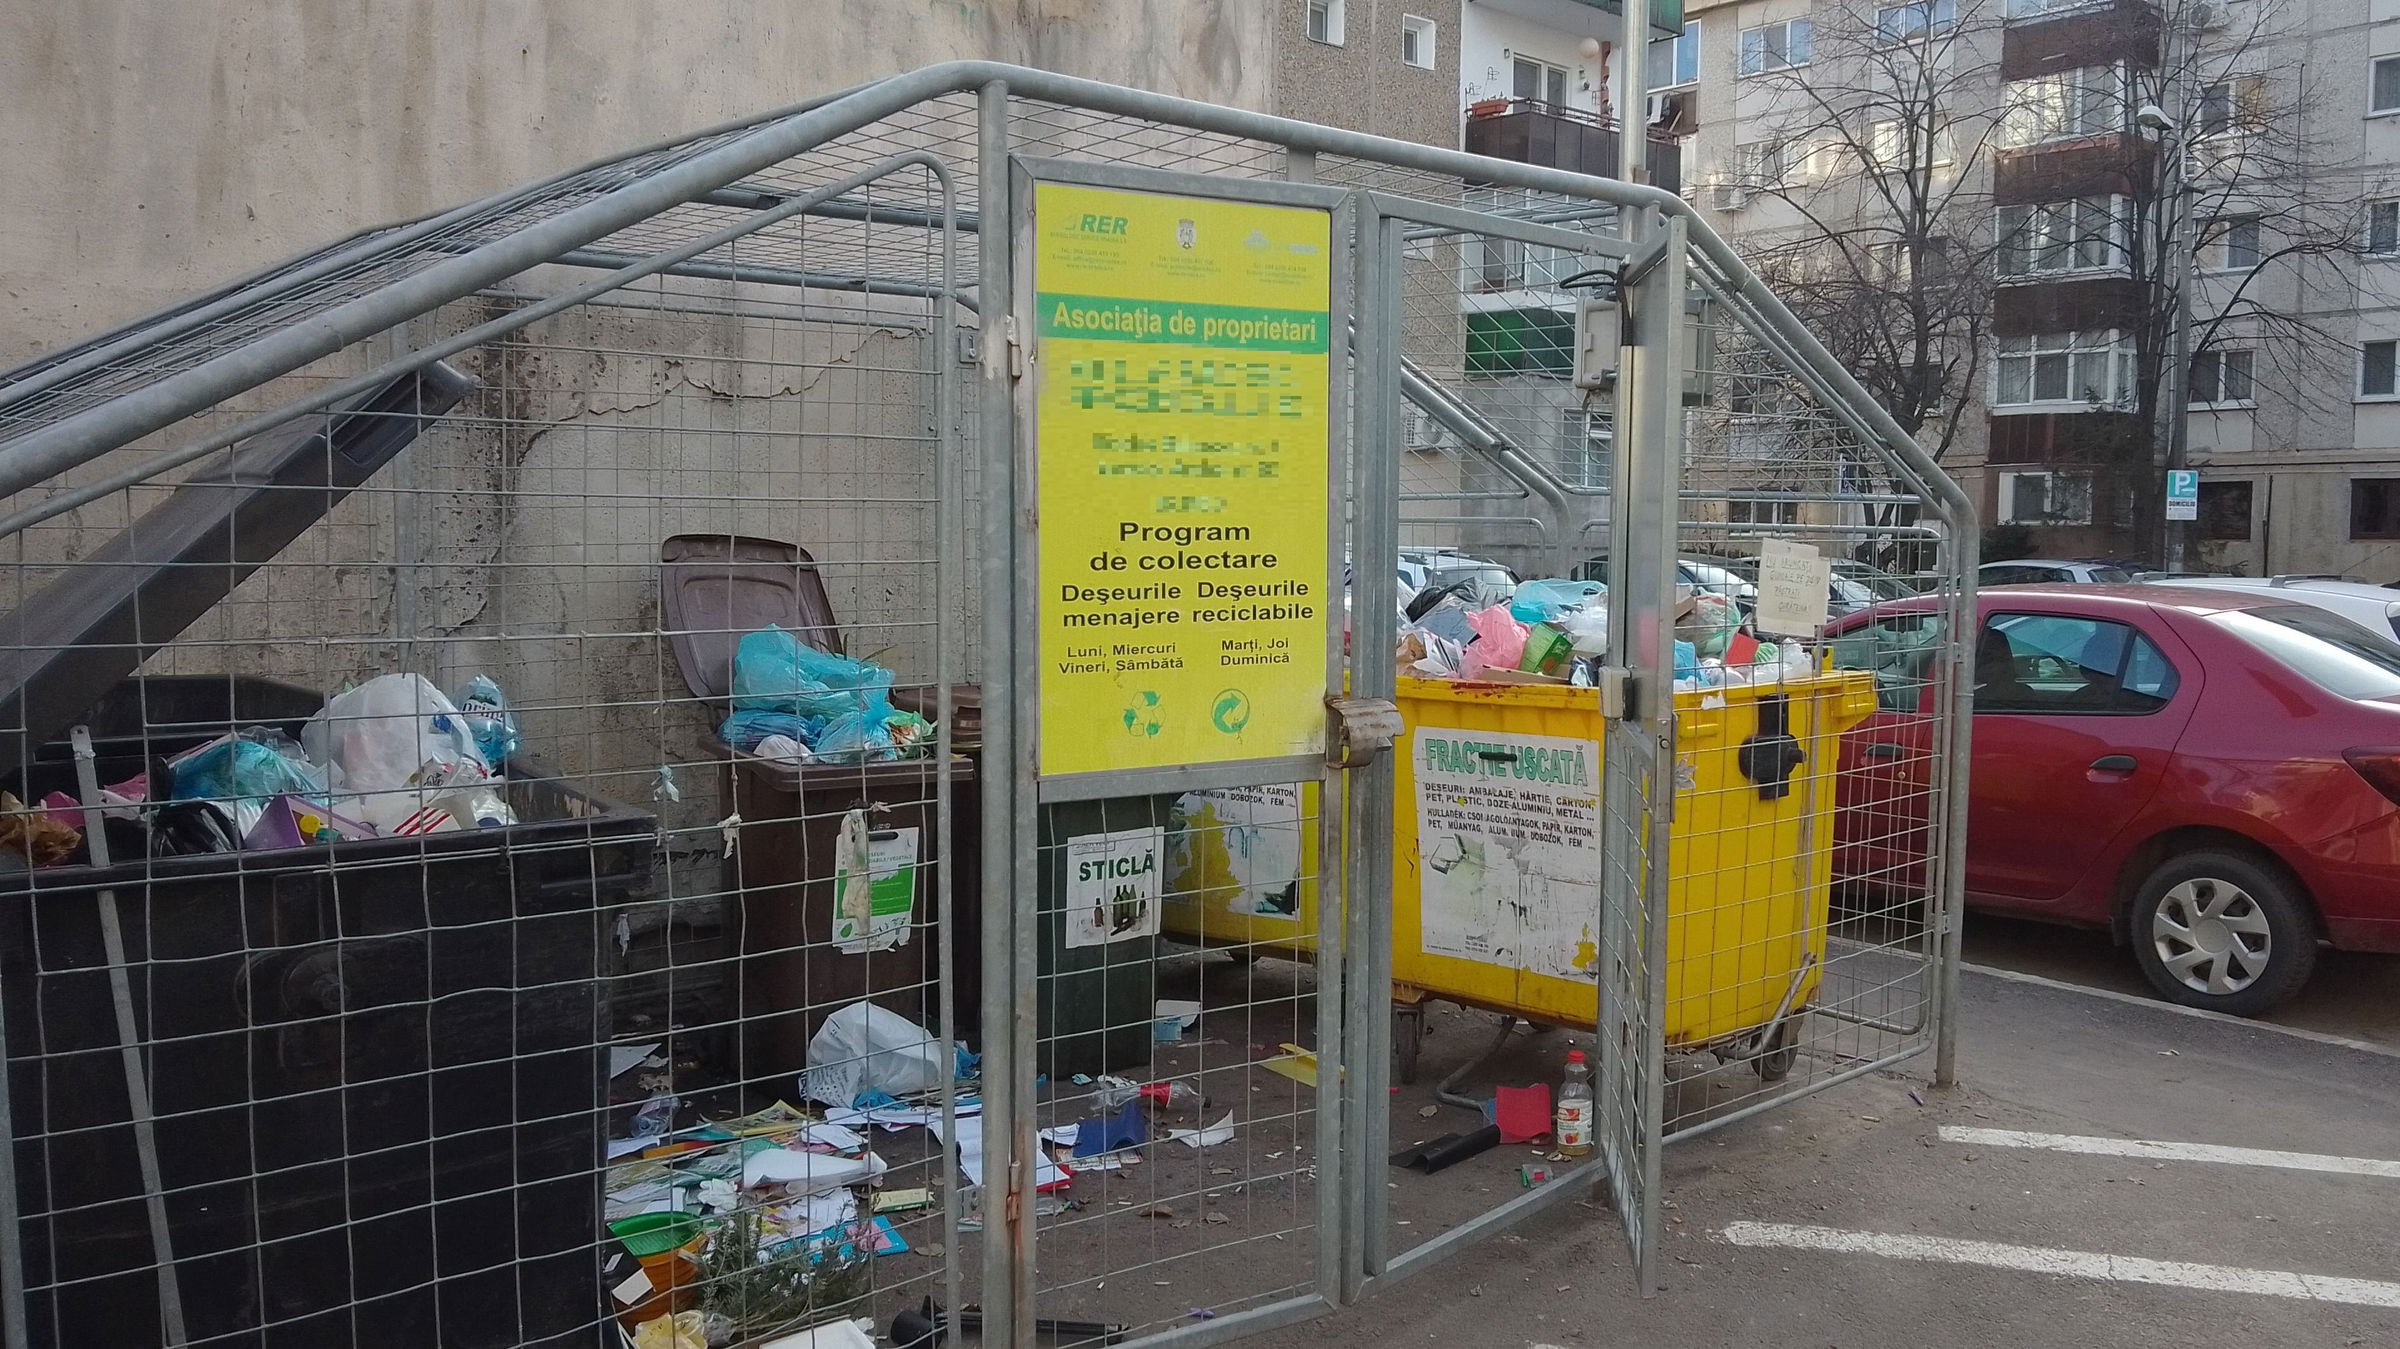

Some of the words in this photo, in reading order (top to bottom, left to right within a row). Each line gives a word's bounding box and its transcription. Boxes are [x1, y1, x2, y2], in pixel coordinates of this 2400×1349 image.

[1081, 214, 1128, 235] RER
[1053, 301, 1162, 338] Asociaţia
[1169, 310, 1197, 336] de
[1203, 316, 1317, 344] proprietari
[1119, 522, 1251, 546] Program
[1090, 552, 1128, 571] de
[1138, 550, 1278, 570] colectare
[1061, 583, 1182, 605] Deşeurile
[1197, 580, 1310, 601] Deşeurile
[1063, 608, 1180, 629] menajere
[1192, 603, 1314, 623] reciclabile
[1067, 646, 1107, 659] Luni,
[1112, 642, 1176, 656] Miercuri
[1221, 639, 1263, 653] Marţi,
[1266, 637, 1289, 650] Joi
[1059, 662, 1111, 675] Vineri,
[1115, 657, 1184, 672] Sâmbătă
[1220, 653, 1290, 667] Duminică
[1510, 744, 1589, 787] USCATĂ
[1426, 793, 1444, 804] PET,
[1556, 807, 1584, 820] METAL
[1428, 819, 1443, 830] PET,
[1564, 824, 1595, 840] KARTON,
[1079, 848, 1157, 882] STICLĂ
